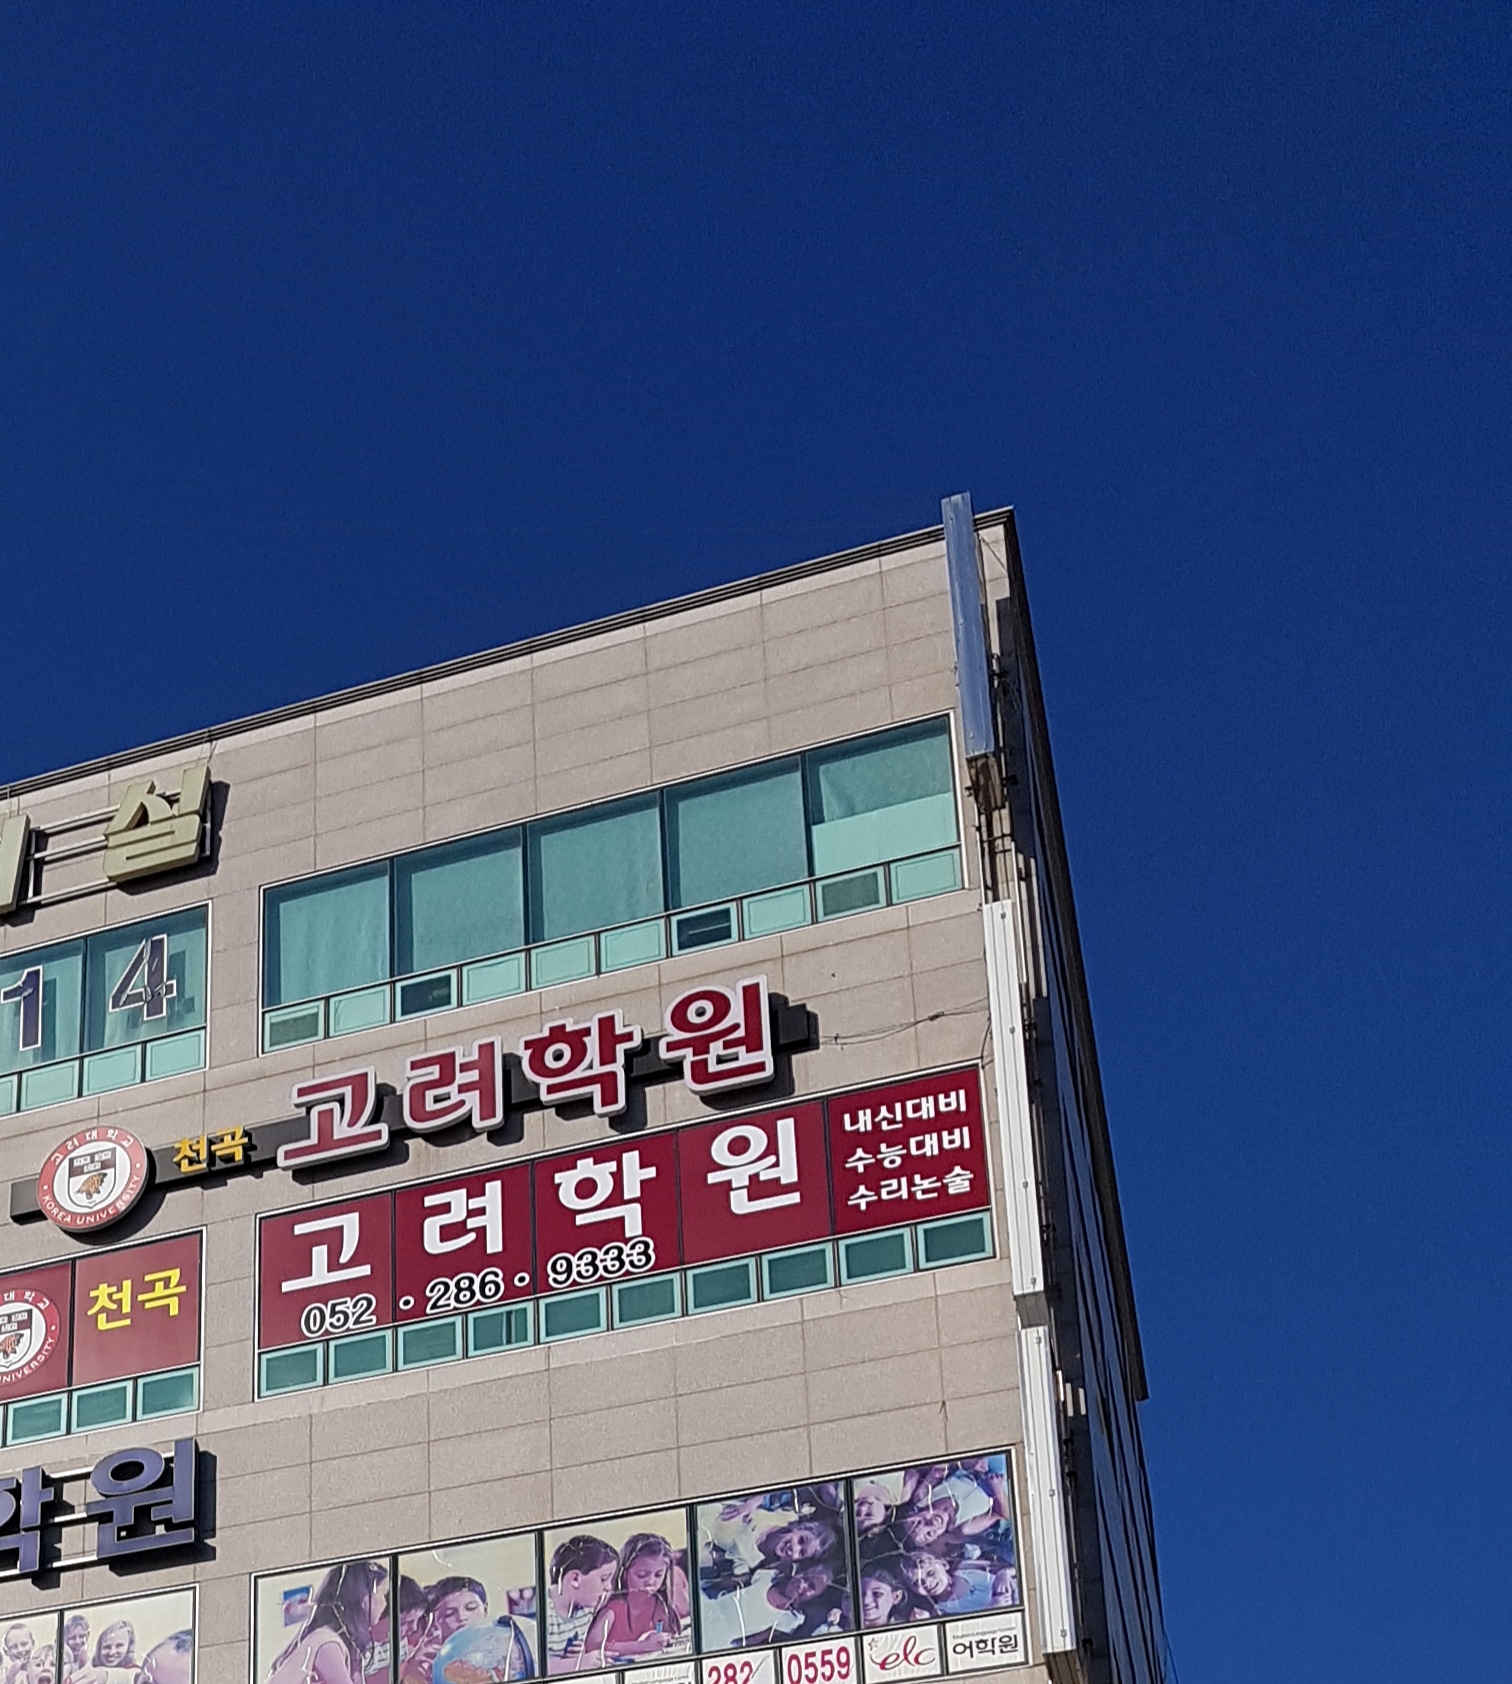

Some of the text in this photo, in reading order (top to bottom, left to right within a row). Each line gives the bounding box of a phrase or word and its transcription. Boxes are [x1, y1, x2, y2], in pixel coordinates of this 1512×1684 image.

[277, 974, 776, 1171] 고려학원
[842, 1088, 968, 1134] 내신대비
[50, 1128, 135, 1166] 고려대학교
[173, 1126, 249, 1174] 천곡
[845, 1125, 972, 1173] 수능대비
[42, 1193, 72, 1225] KOREA
[846, 1165, 974, 1211] 수리논술
[87, 1267, 187, 1331] 천곡
[951, 1635, 1019, 1661] 어학원
